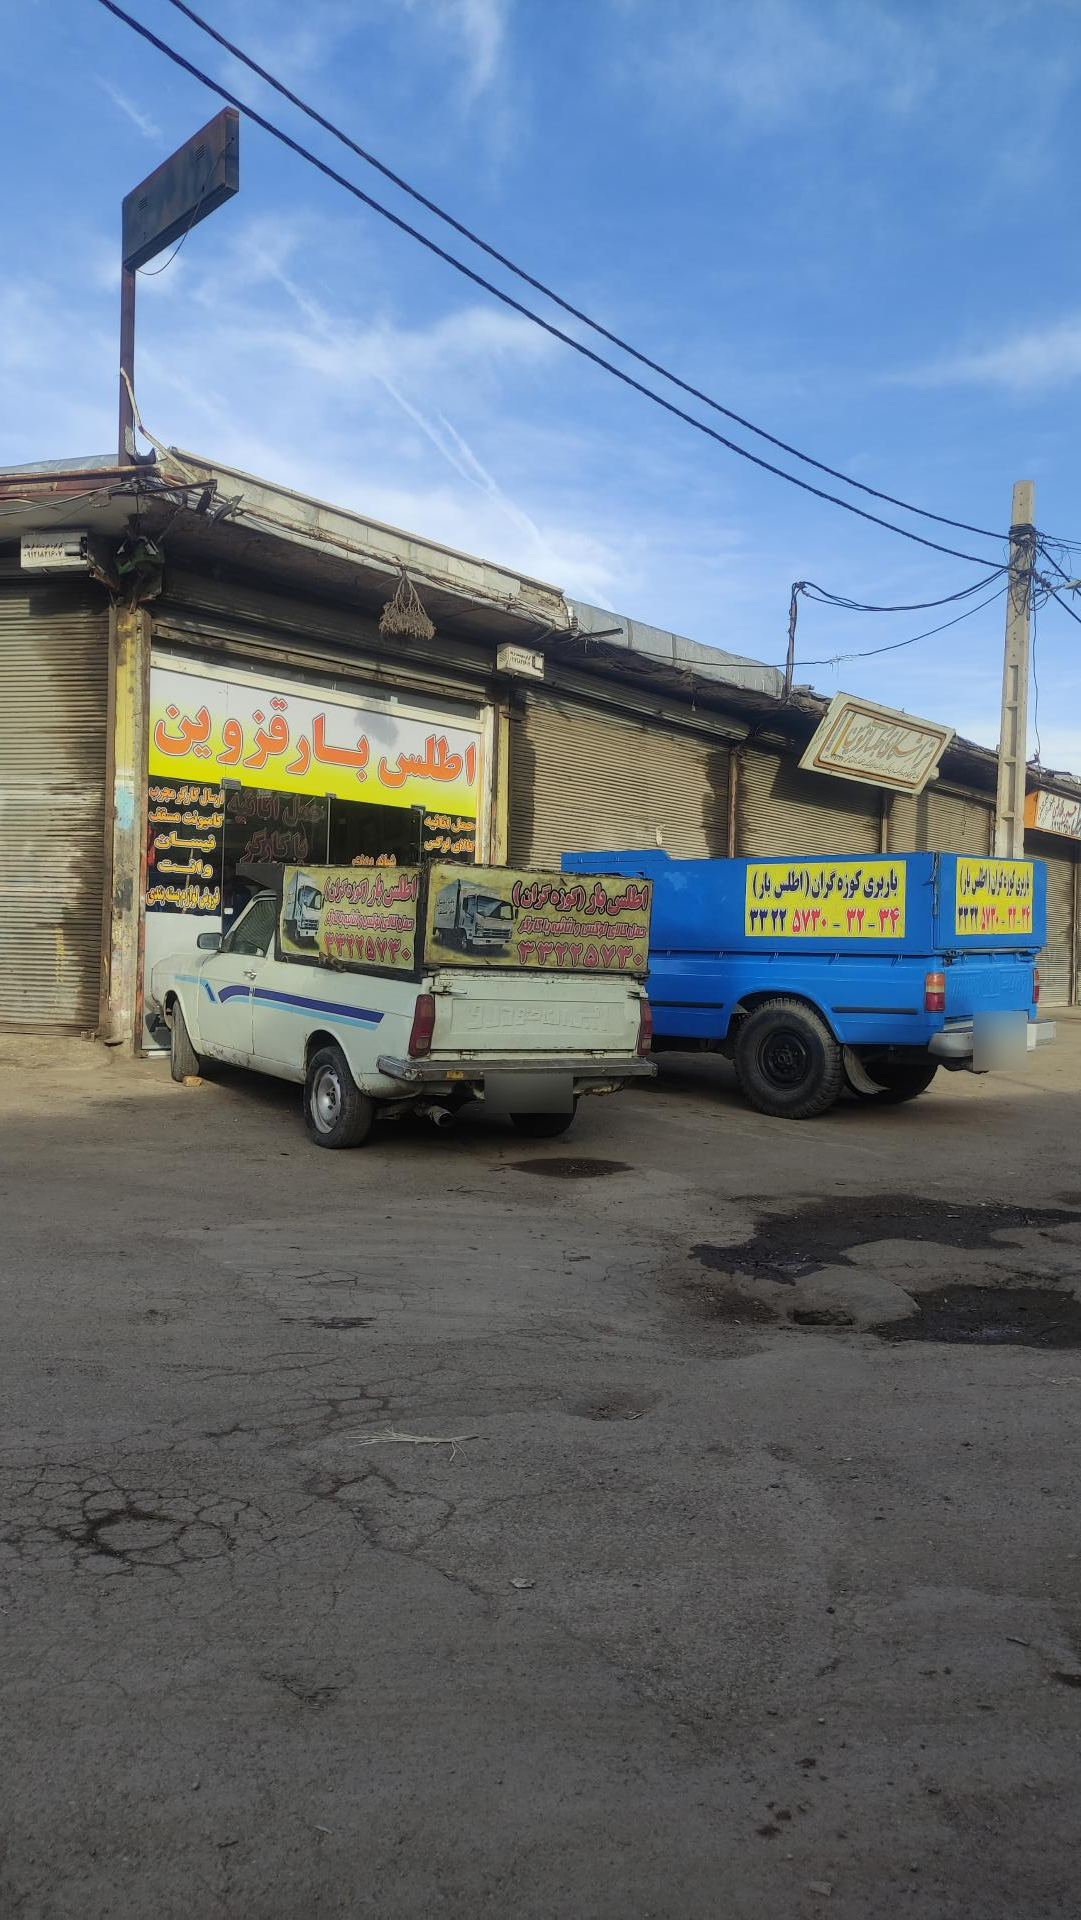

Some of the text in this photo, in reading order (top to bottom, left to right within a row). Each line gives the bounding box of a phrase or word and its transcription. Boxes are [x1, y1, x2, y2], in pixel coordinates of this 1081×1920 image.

[154, 697, 476, 788] اطلس بار قزوین
[148, 786, 225, 808] ارسال کارگر مجرب
[148, 807, 225, 830] کامیونت مسقف
[424, 814, 476, 832] حمل اثاثیه
[154, 831, 216, 852] نیسان
[424, 836, 474, 853] کالای لوکس
[157, 858, 213, 878] وانت
[365, 872, 384, 907] بار
[382, 874, 418, 908] اطلس
[811, 869, 836, 899] گران
[837, 869, 862, 899] کوزه
[863, 868, 898, 898] باربری
[1015, 868, 1030, 896] باربری
[198, 886, 221, 910] فروش
[585, 882, 607, 915] بار
[606, 884, 649, 916] اطلس
[580, 921, 608, 937] لوکس
[749, 908, 768, 932] ۳۳
[770, 908, 787, 932] ۲۲
[792, 908, 828, 933] ۵۷۳۰
[846, 908, 865, 933] ۳۲
[878, 907, 900, 933] ۳۴
[958, 906, 969, 929] ۳۳
[627, 923, 647, 940] حمل
[324, 931, 412, 963] ۳۳۲۲۵۷۳۰
[517, 939, 644, 970] ۳۳۲۲۵۷۳۰
